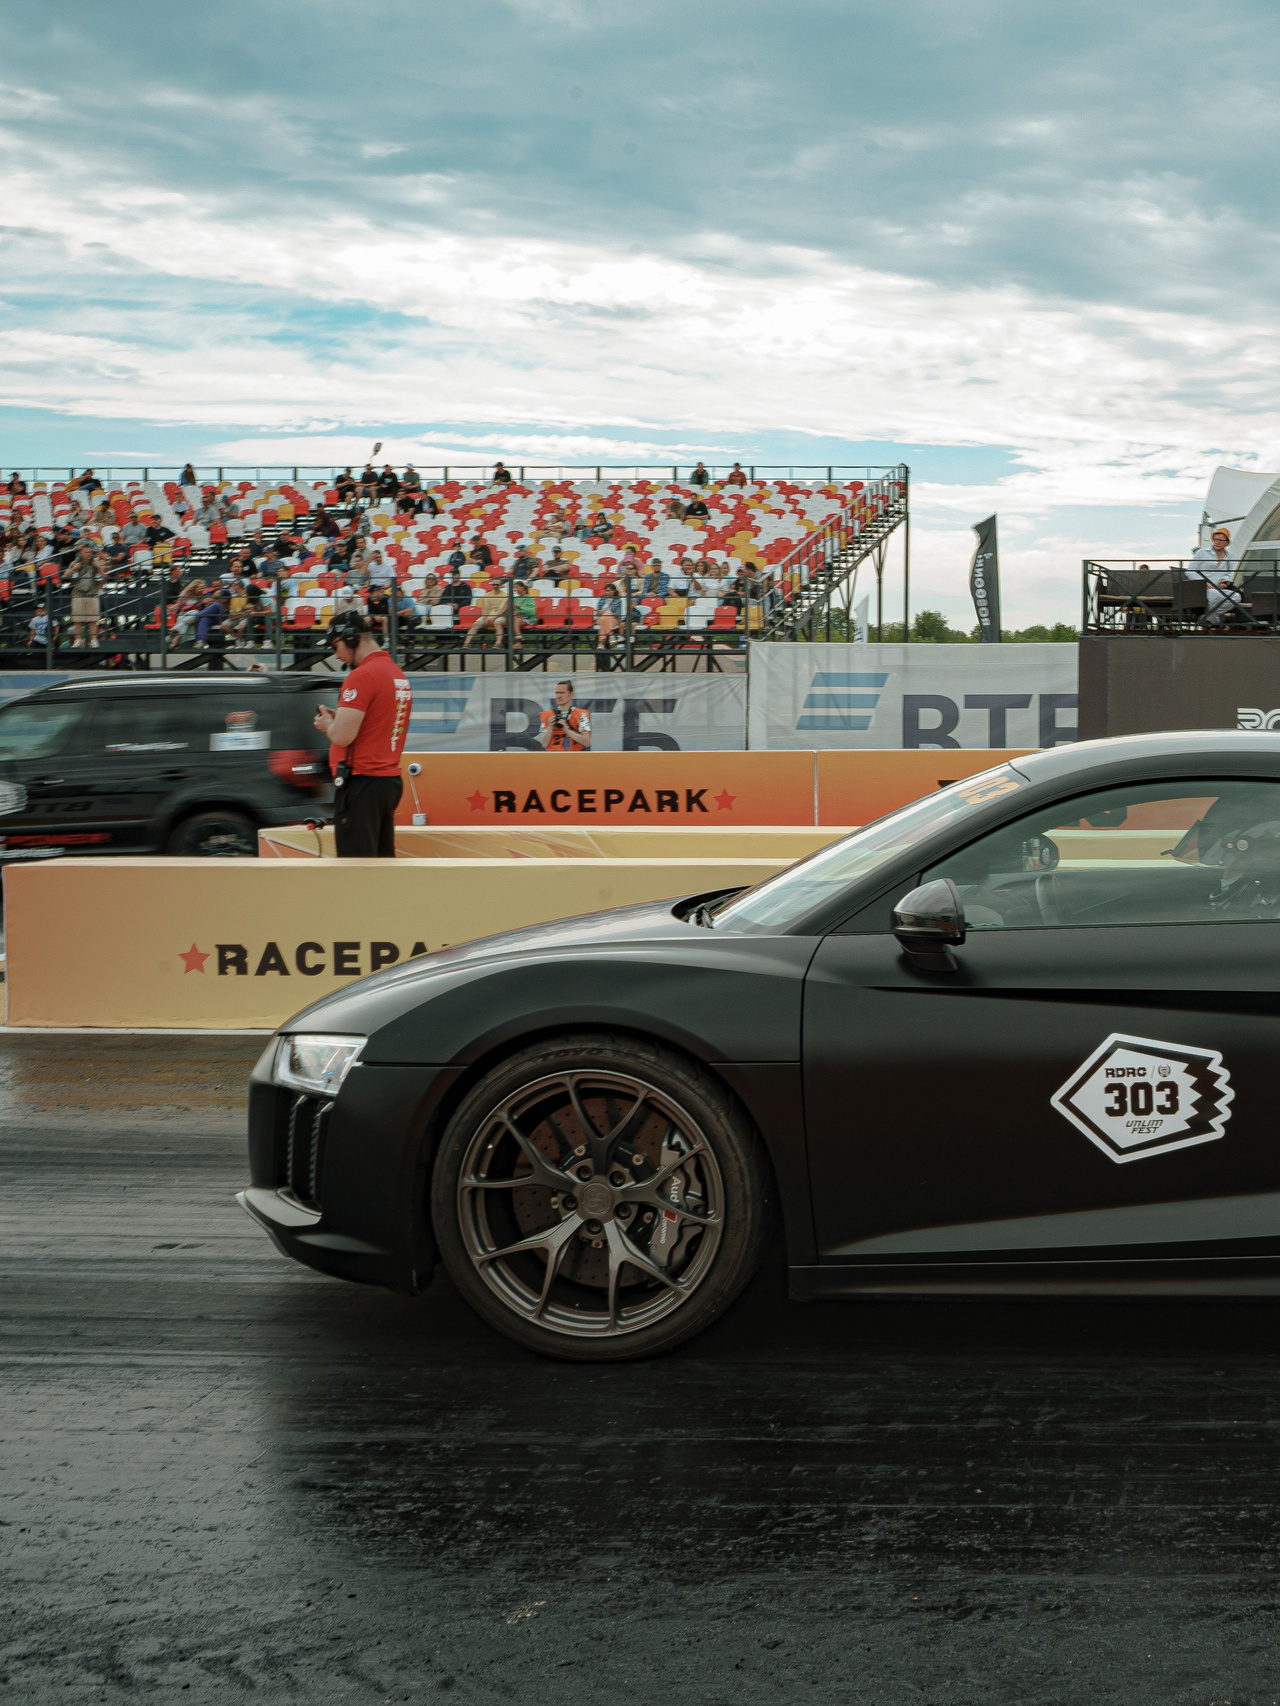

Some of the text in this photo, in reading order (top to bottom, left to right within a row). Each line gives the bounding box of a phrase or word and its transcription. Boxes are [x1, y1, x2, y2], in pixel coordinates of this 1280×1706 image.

[493, 789, 709, 813] RACEPARK
[215, 941, 449, 977] RACEP
[1104, 1067, 1147, 1078] RDRC
[1104, 1081, 1179, 1117] 303
[669, 1176, 682, 1203] Aud
